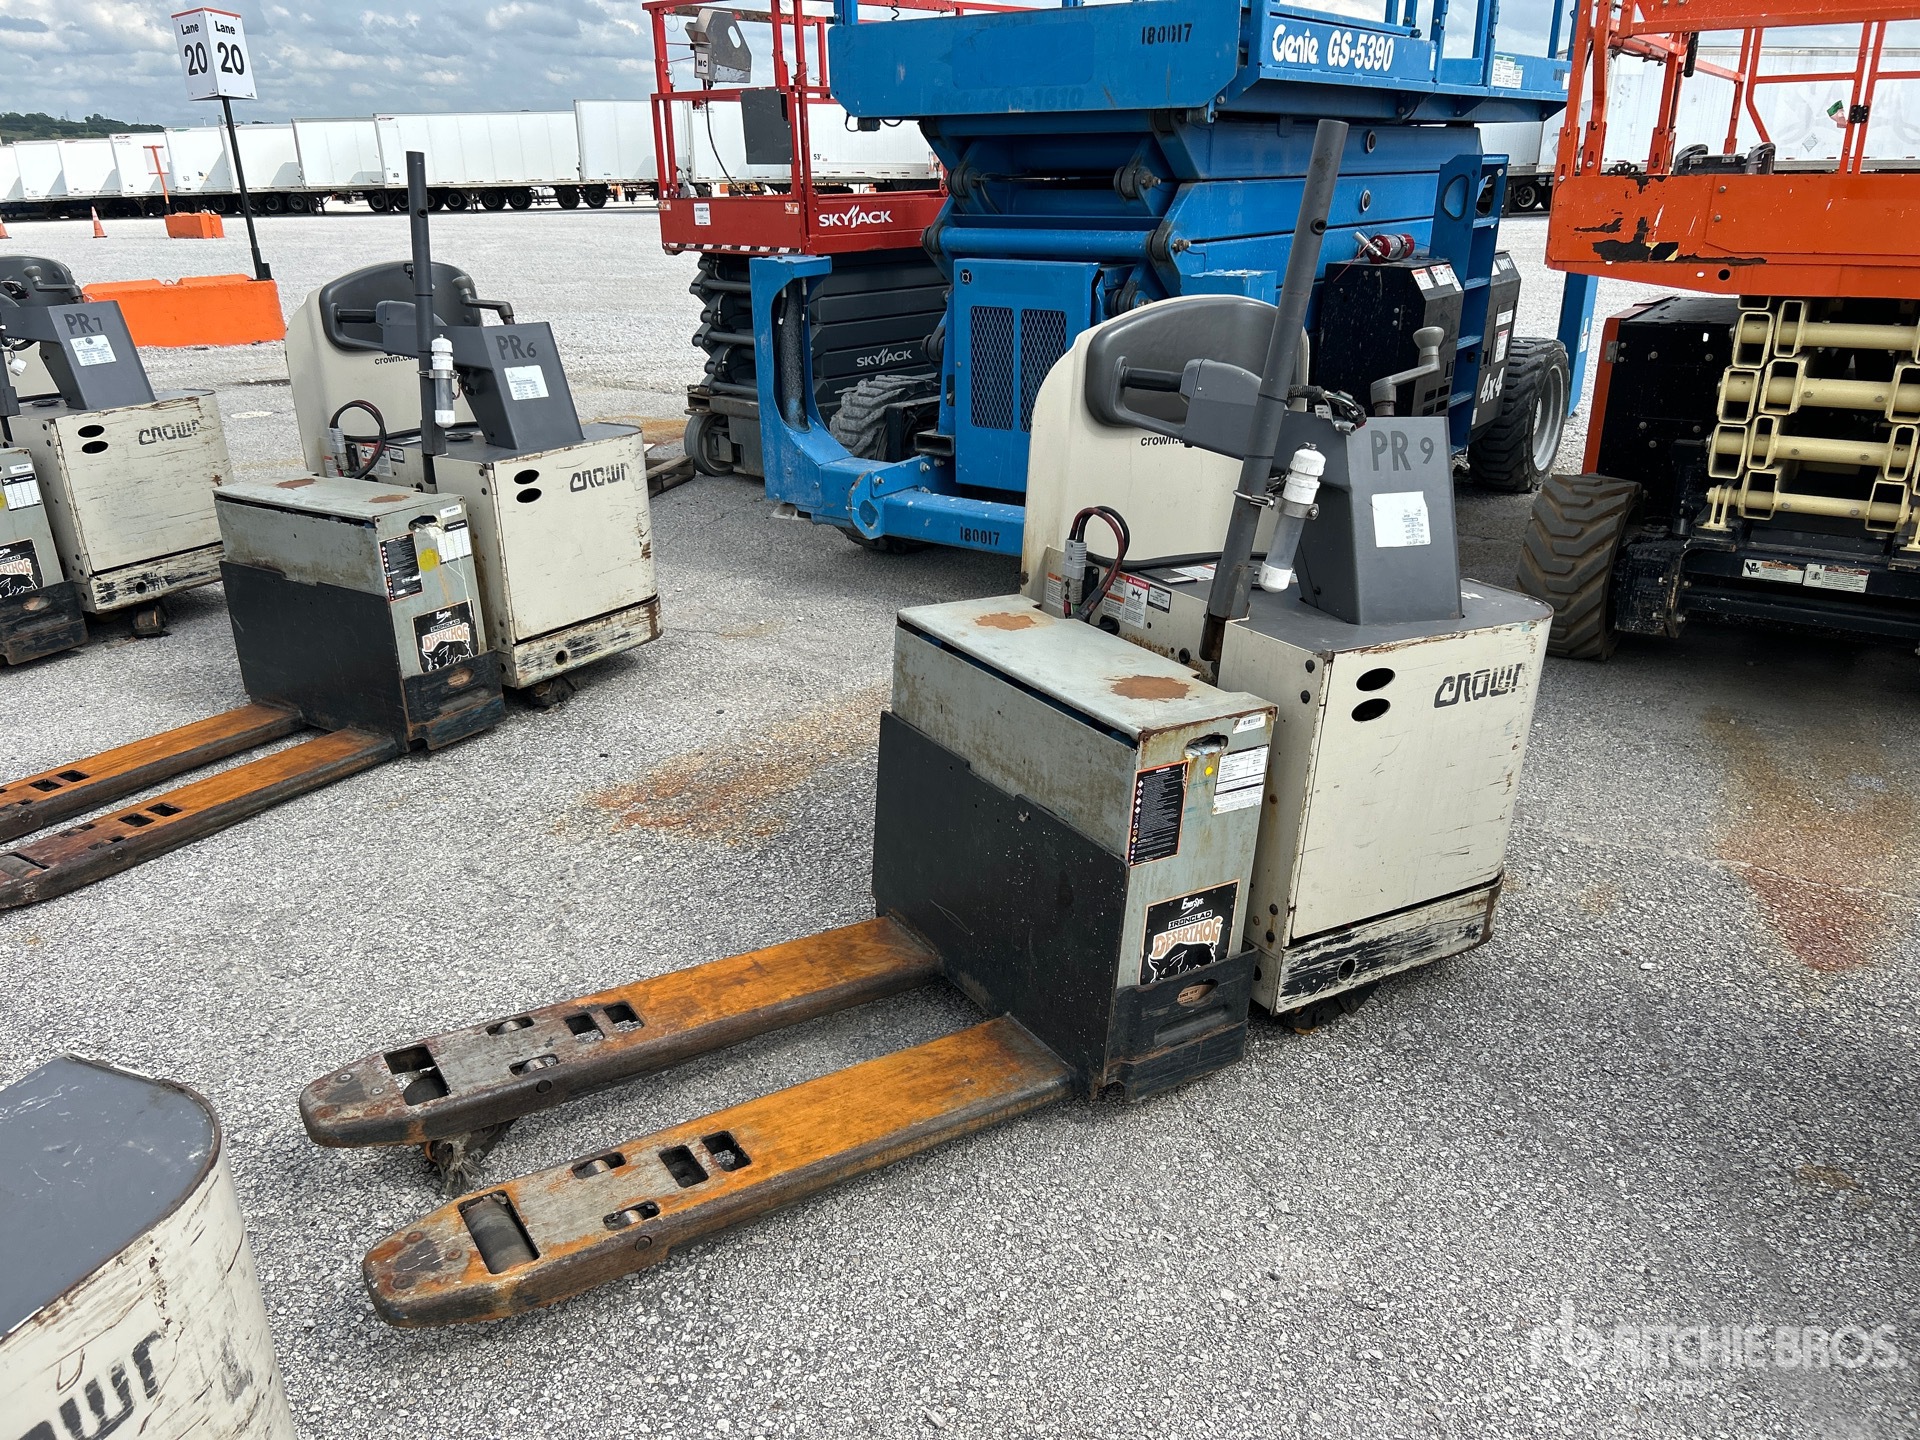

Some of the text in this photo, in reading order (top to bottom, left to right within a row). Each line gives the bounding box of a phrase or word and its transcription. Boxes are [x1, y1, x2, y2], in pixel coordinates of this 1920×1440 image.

[181, 24, 199, 35] Lane
[215, 20, 235, 35] Lane
[1141, 23, 1193, 45] 180017
[184, 42, 208, 76] 20
[217, 42, 244, 75] 20
[1272, 24, 1394, 72] Genie GS-5390
[818, 204, 893, 228] SKYJACK
[856, 347, 913, 367] SKYJACK
[1480, 367, 1505, 404] 4x4
[960, 526, 1000, 546] 180017
[422, 622, 470, 652] DESERTHOG
[1168, 909, 1213, 929] IRONCLAD
[1152, 916, 1223, 959] DESERTHOG
